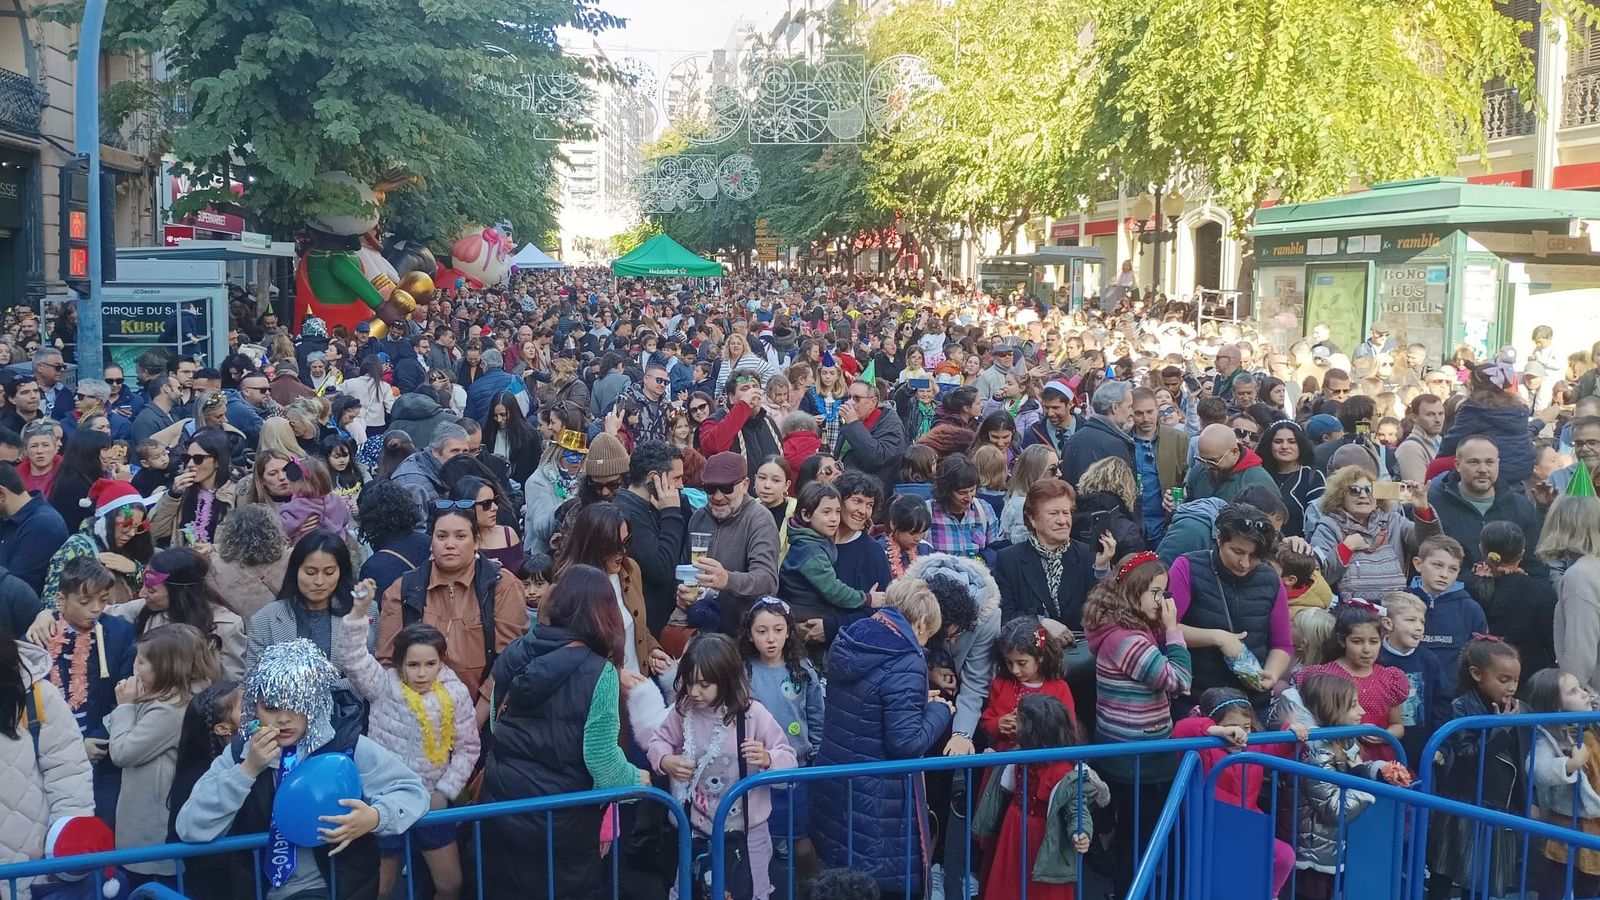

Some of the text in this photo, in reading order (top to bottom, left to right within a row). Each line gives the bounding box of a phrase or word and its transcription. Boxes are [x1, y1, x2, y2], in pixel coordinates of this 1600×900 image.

[1397, 233, 1440, 249] rambla
[1273, 242, 1304, 256] rambla
[1391, 285, 1424, 297] BUS
[101, 306, 144, 318] CIRQUE
[146, 306, 163, 315] DU
[271, 829, 289, 865] UEVO
